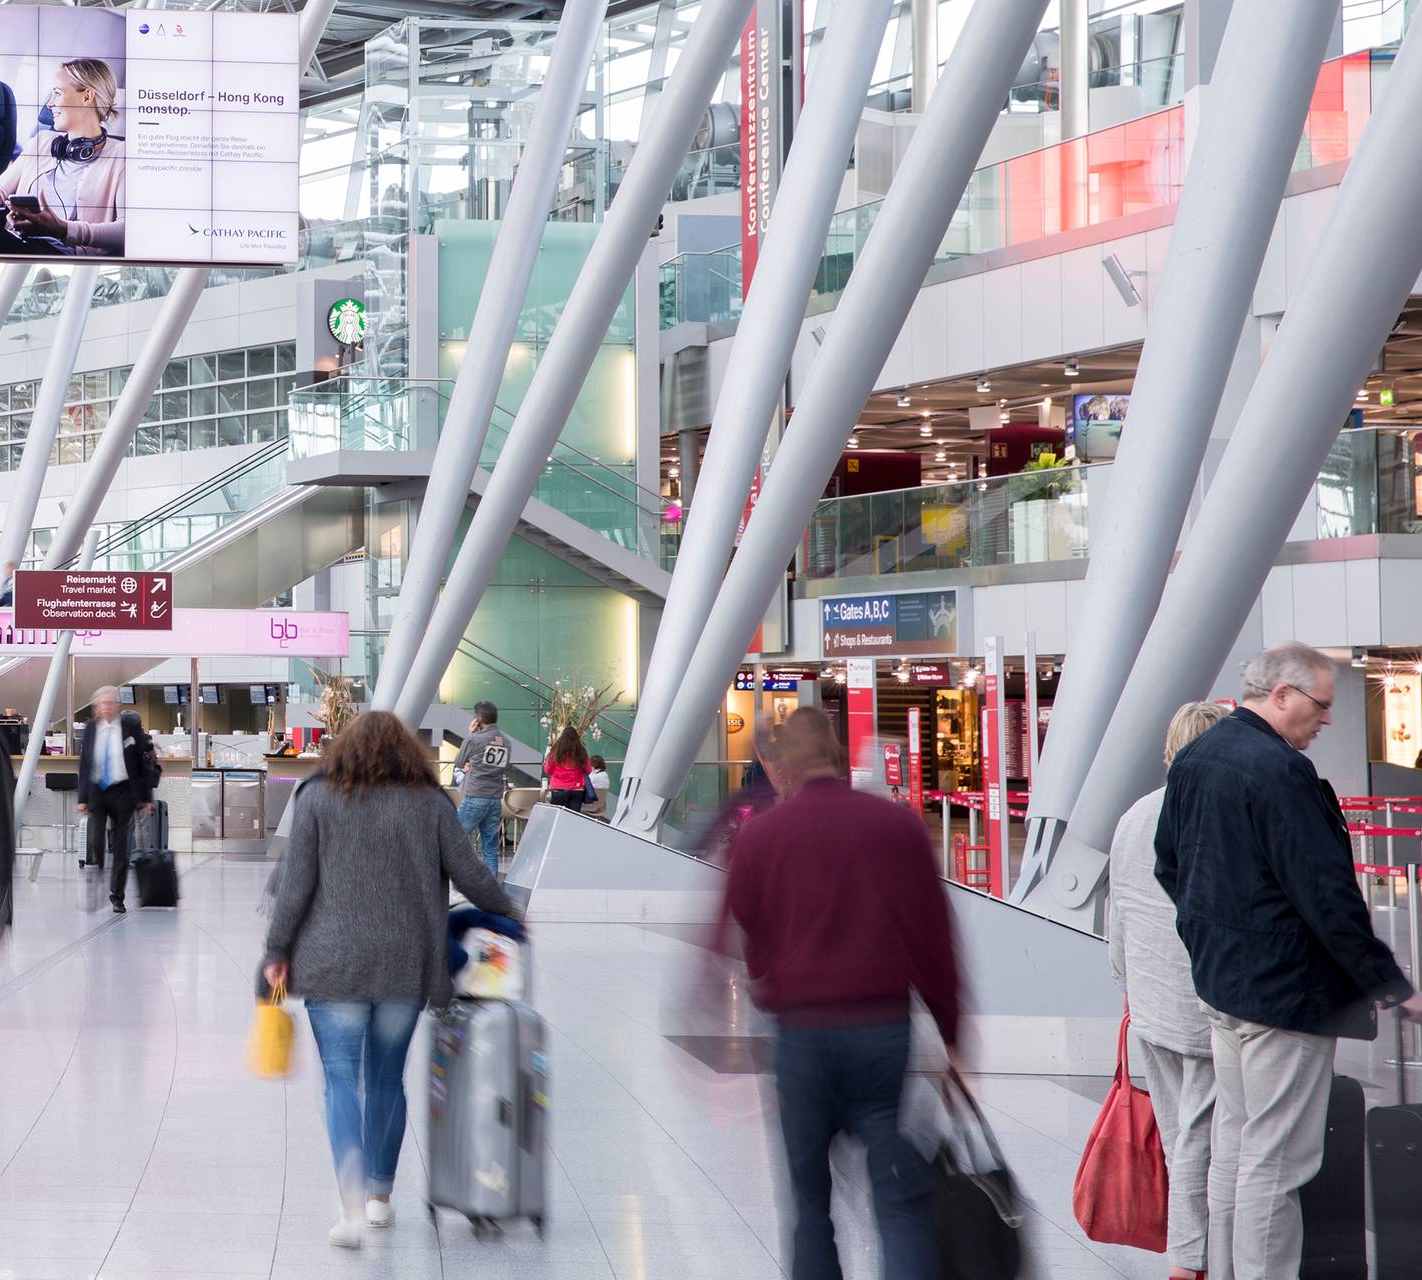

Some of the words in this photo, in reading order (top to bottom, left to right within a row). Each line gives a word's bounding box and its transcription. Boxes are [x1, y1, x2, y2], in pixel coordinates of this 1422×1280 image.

[759, 27, 769, 100] Center
[138, 89, 205, 101] Düsseldorf
[218, 91, 249, 105] Hong
[253, 92, 284, 106] Kong
[138, 105, 191, 117] nonstop.
[747, 29, 757, 236] Konferenzzentrum
[760, 106, 770, 233] Conference
[203, 228, 244, 238] CATHAY
[247, 229, 286, 239] PACIFIC
[66, 575, 116, 584] Reisemarkt
[61, 585, 85, 594] Travel
[87, 585, 116, 594] market
[37, 598, 116, 609] Flughafenterrasse
[840, 602, 863, 621] Gates
[864, 600, 889, 623] A,B,C
[42, 609, 94, 618] Observation
[96, 609, 116, 618] deck
[840, 634, 857, 649] Shops
[861, 633, 892, 646] Restaurants
[485, 747, 506, 766] 67
